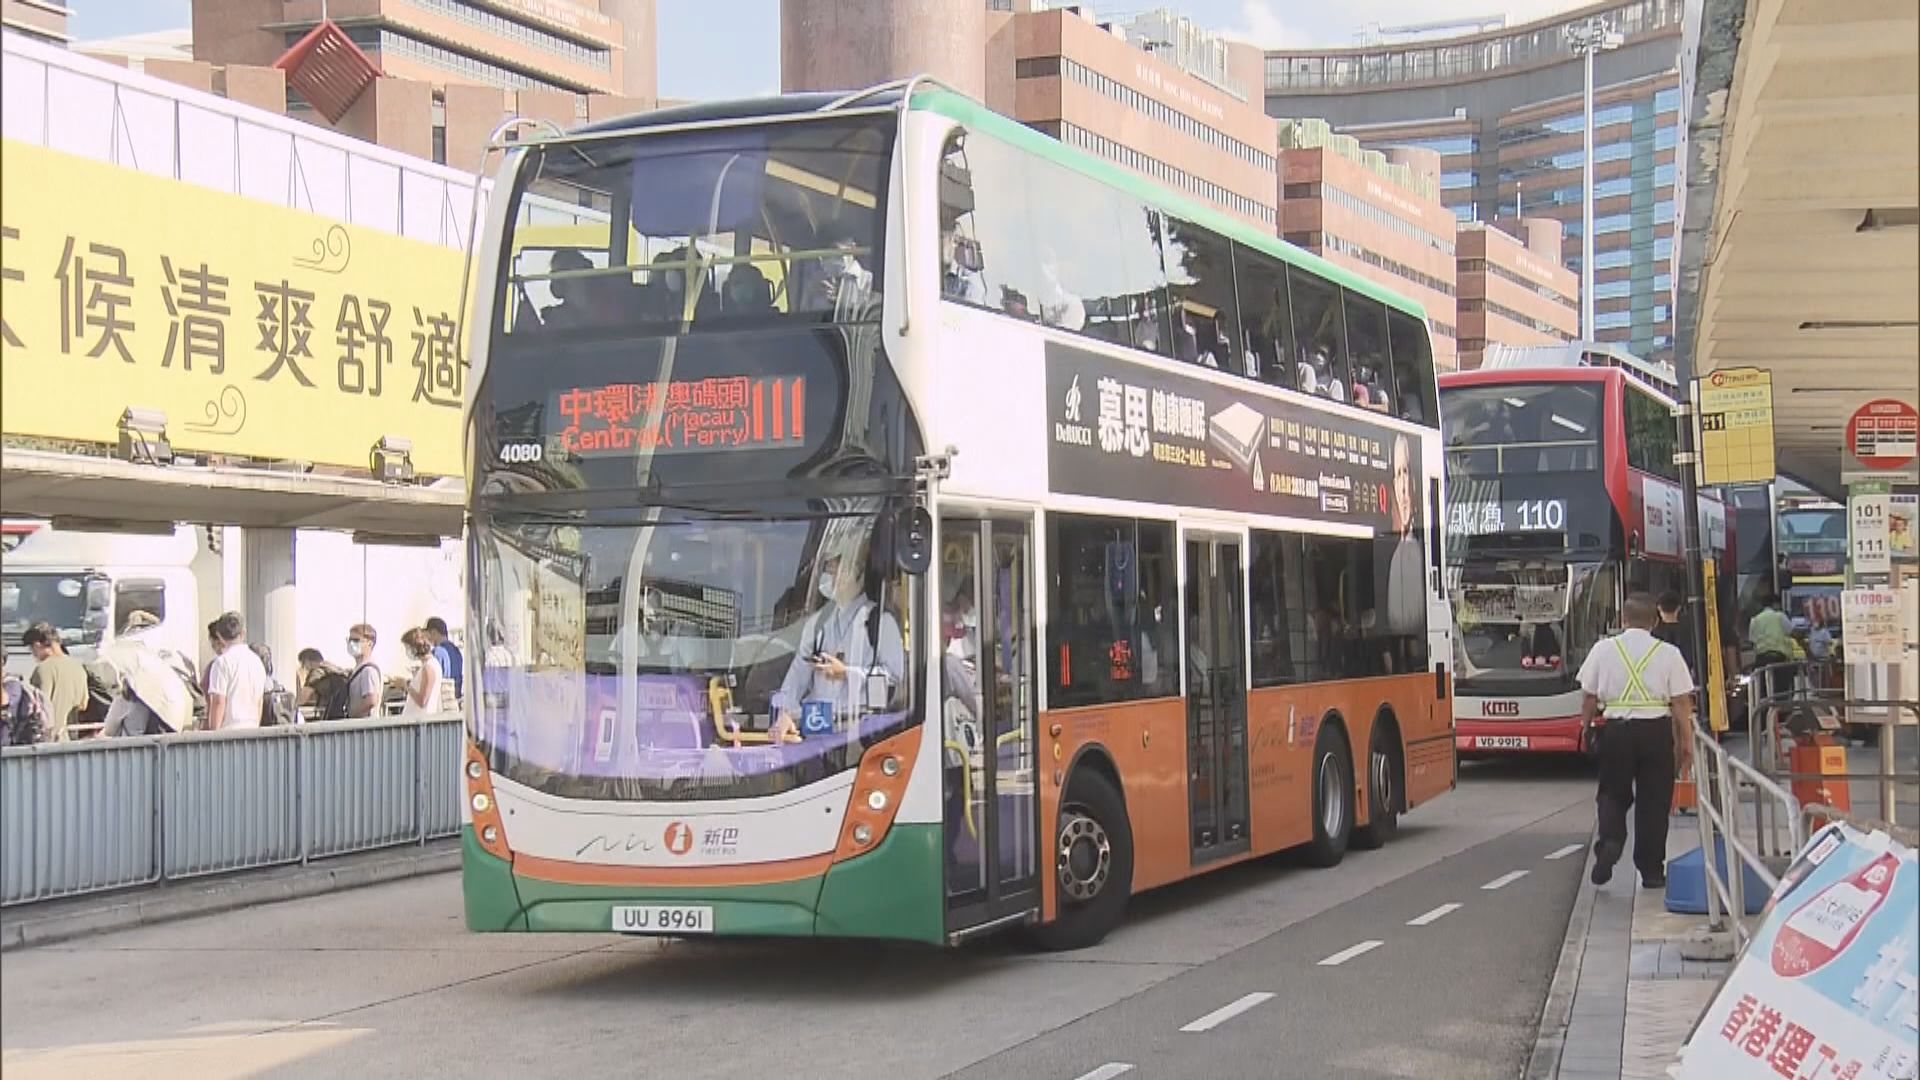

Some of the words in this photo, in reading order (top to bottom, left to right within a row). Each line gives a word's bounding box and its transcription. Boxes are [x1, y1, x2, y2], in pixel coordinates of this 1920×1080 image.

[752, 376, 806, 441] 111
[1097, 376, 1150, 457] 慕思
[500, 443, 542, 464] 4080
[1516, 499, 1563, 530] 110
[1856, 505, 1882, 517] 101
[1856, 539, 1883, 552] 111
[1481, 700, 1520, 717] KMB
[1481, 738, 1495, 746] VD
[704, 827, 739, 847] 新巴
[624, 909, 649, 927] UU
[658, 909, 703, 929] 8961
